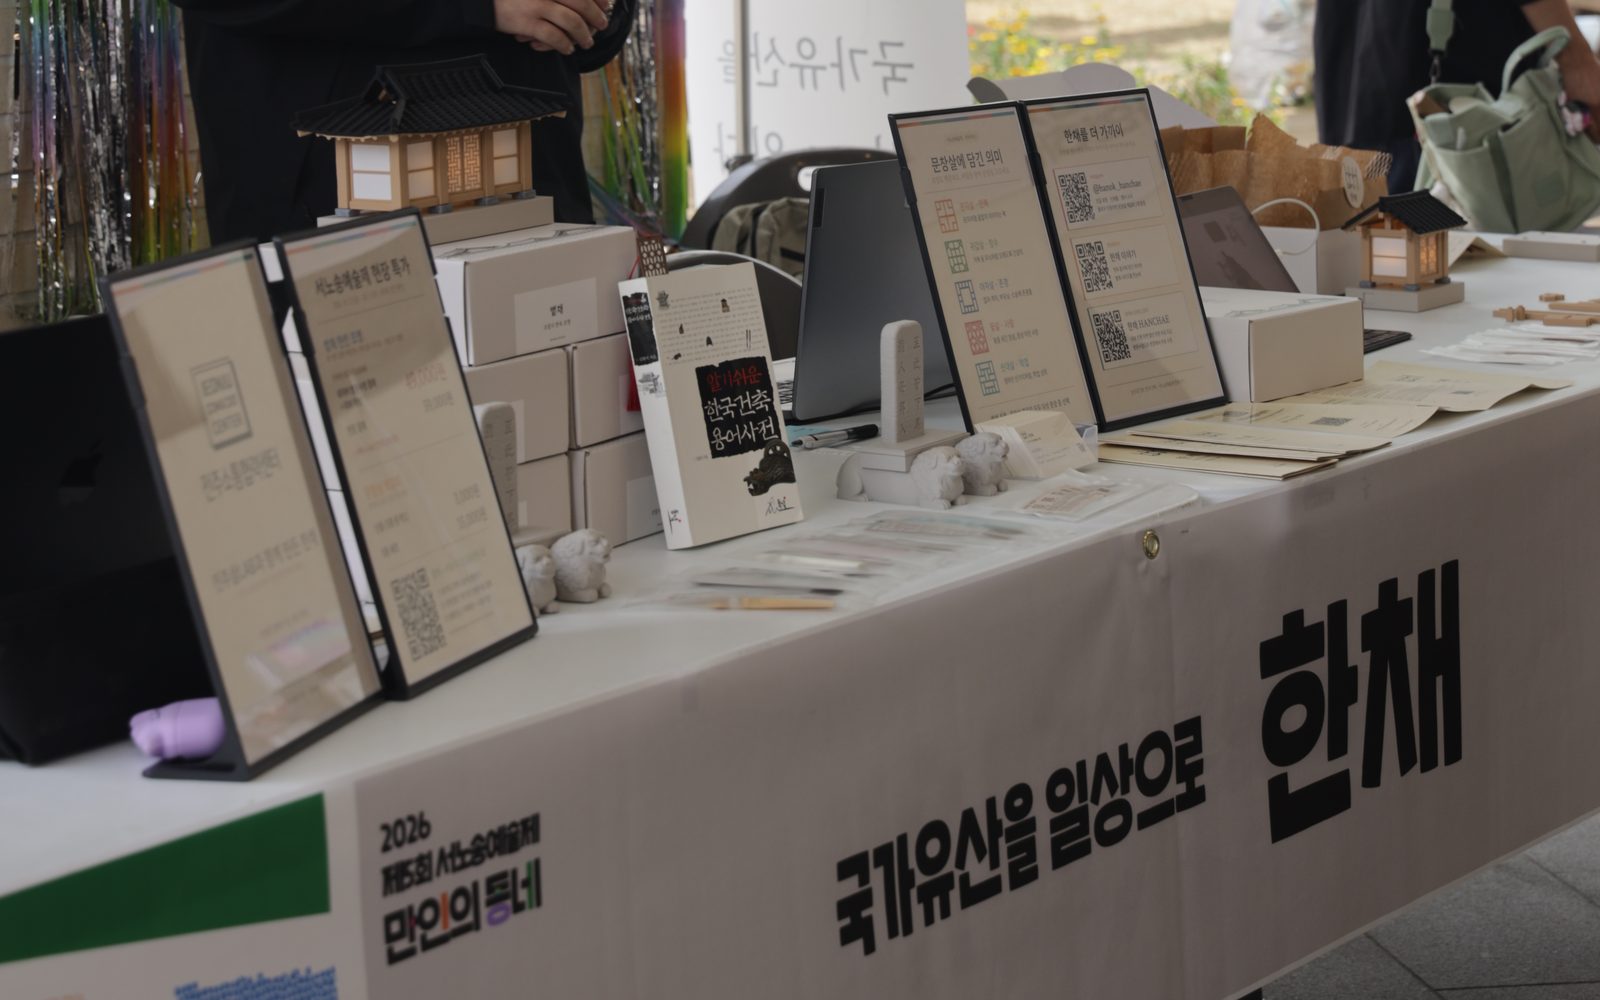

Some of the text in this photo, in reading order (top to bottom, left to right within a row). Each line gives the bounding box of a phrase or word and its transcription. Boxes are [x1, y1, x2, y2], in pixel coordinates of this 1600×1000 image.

[1064, 122, 1124, 144] 한채를 더 가까이
[931, 148, 1004, 174] 문창살에 담긴 의미
[390, 256, 411, 278] 특가
[1138, 315, 1170, 330] HANCHAE
[706, 366, 762, 393] 알기쉬운
[704, 389, 772, 422] 한국건축
[711, 416, 779, 451] 용어사전
[1259, 559, 1462, 844] 한채
[380, 810, 432, 853] 2026
[836, 714, 1207, 956] 국가유산을 일상으로
[381, 812, 540, 898] 제5회 서노송예술제
[384, 857, 542, 967] 만인의 동네
